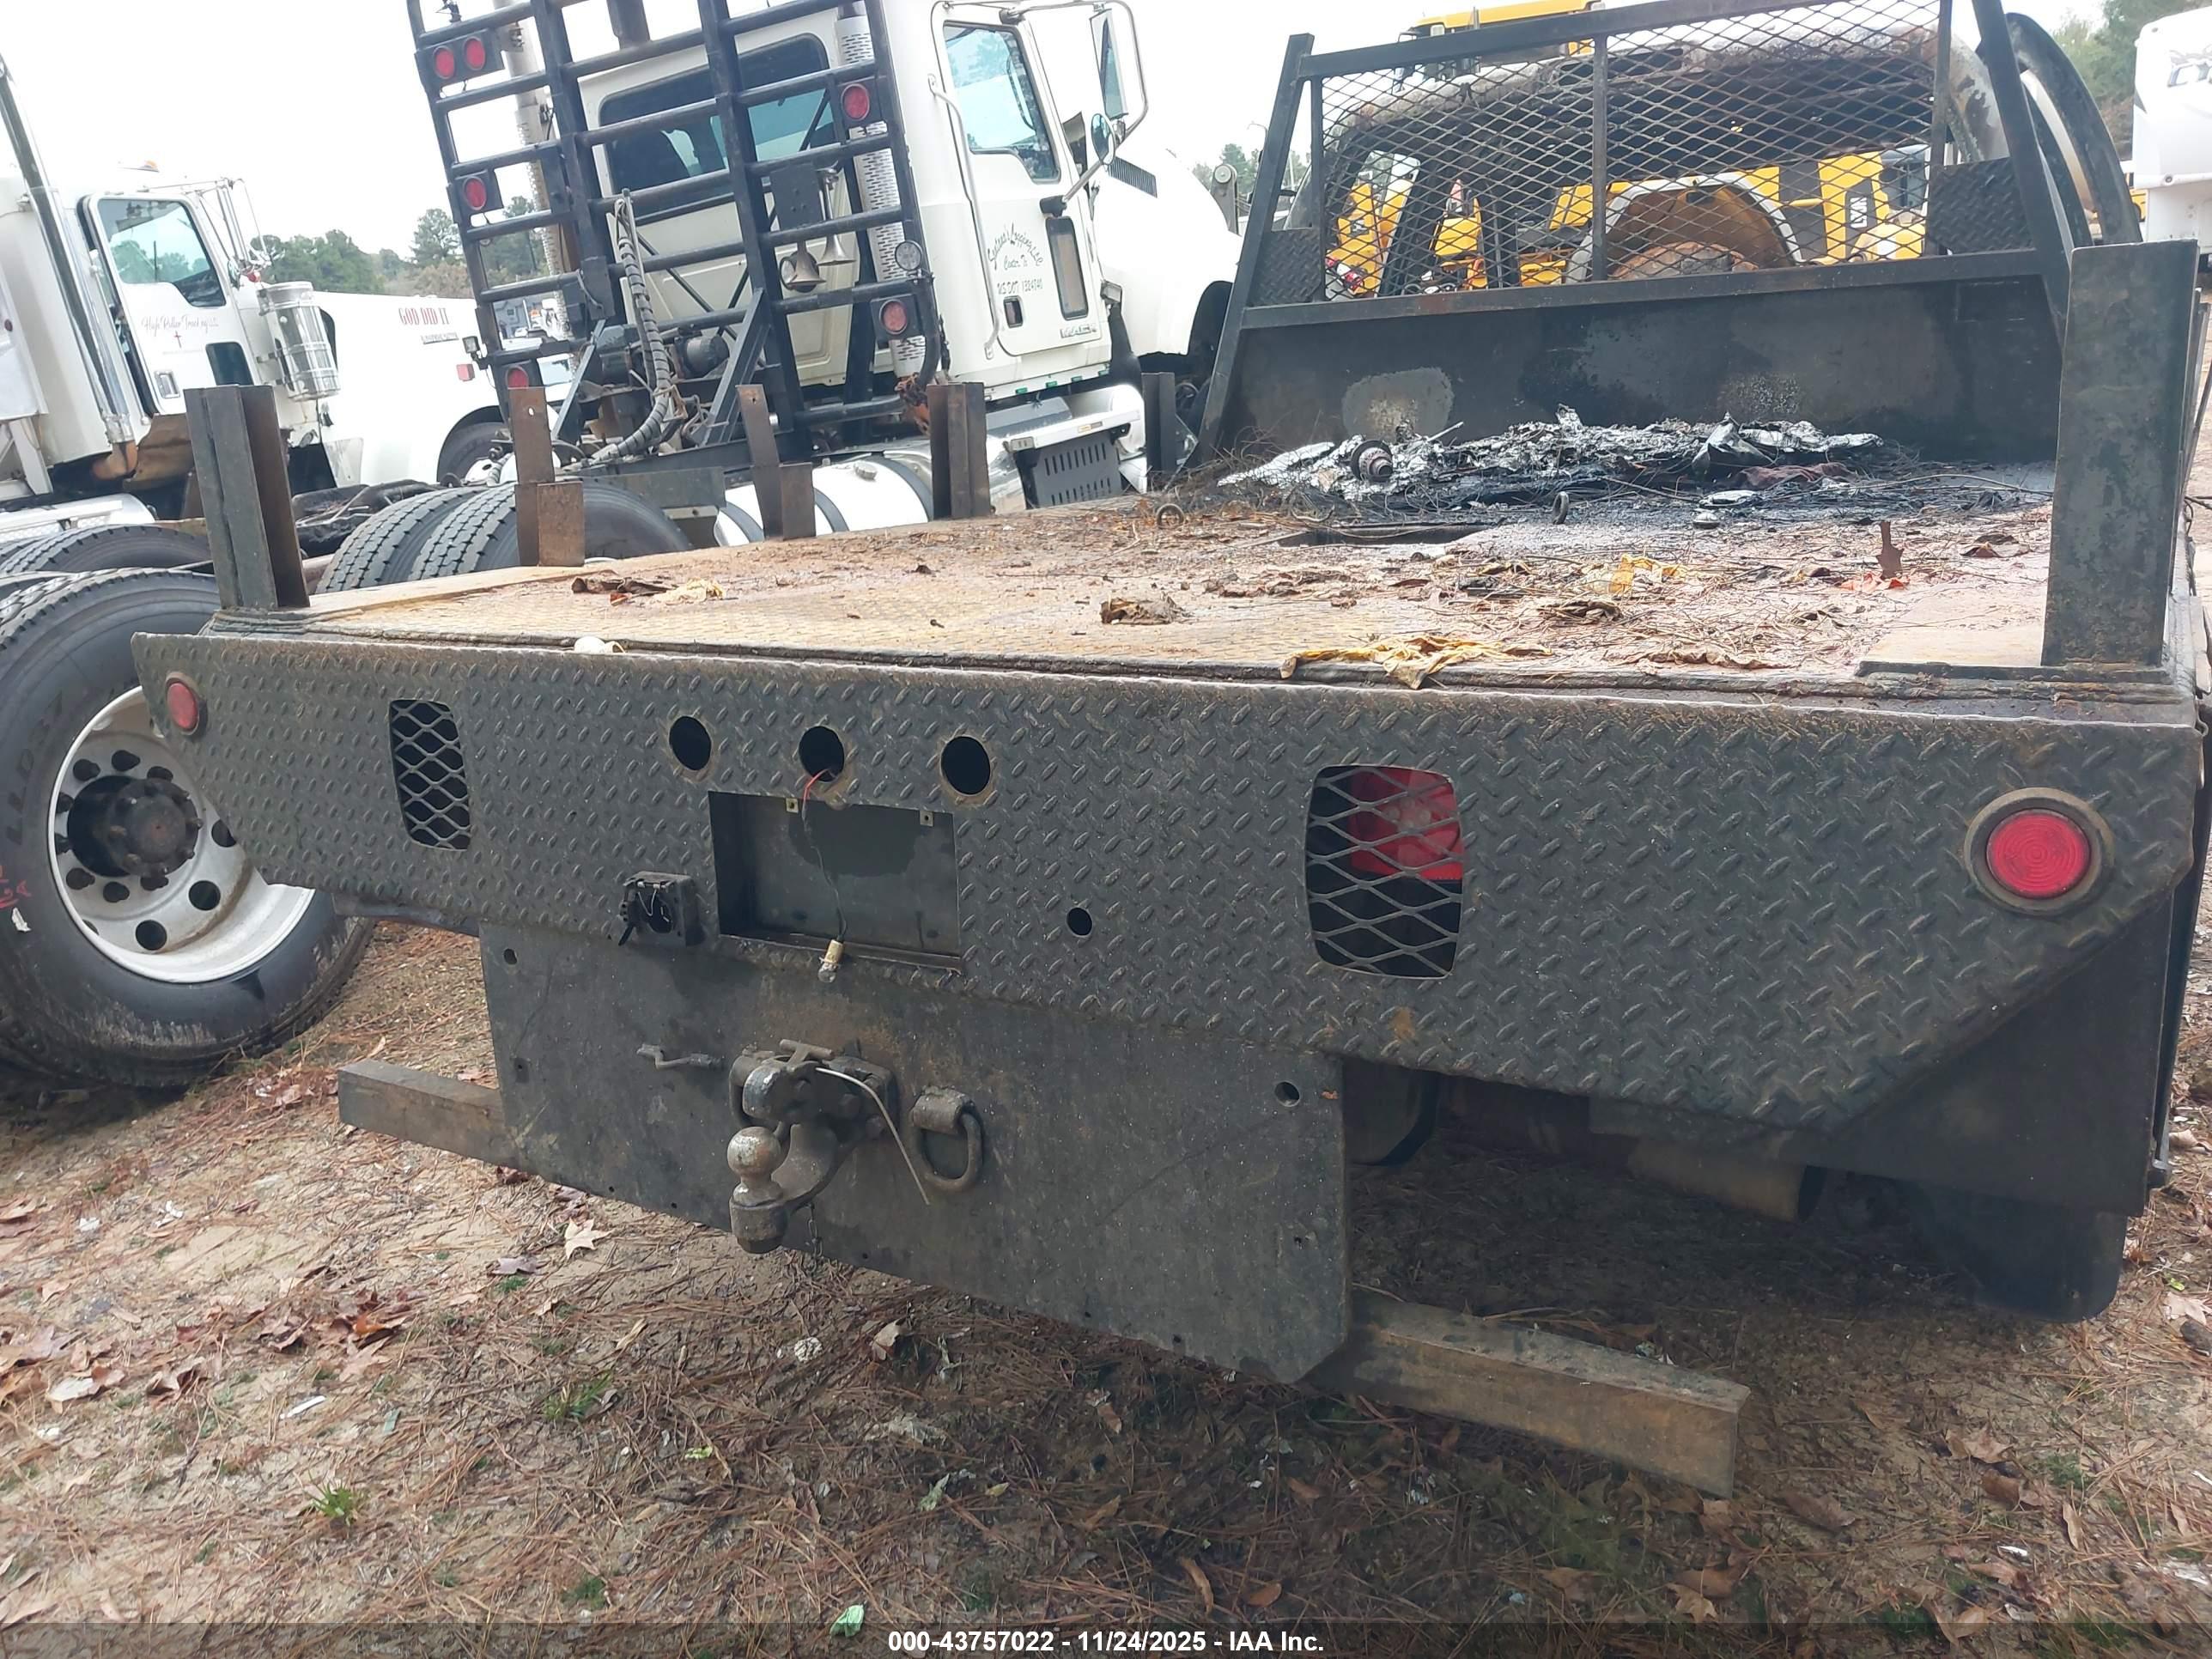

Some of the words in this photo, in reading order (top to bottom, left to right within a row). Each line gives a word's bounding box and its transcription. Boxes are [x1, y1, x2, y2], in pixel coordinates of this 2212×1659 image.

[398, 307, 420, 325] GOD
[420, 307, 439, 325] DID
[438, 307, 450, 325] IT
[1060, 323, 1097, 339] MACK
